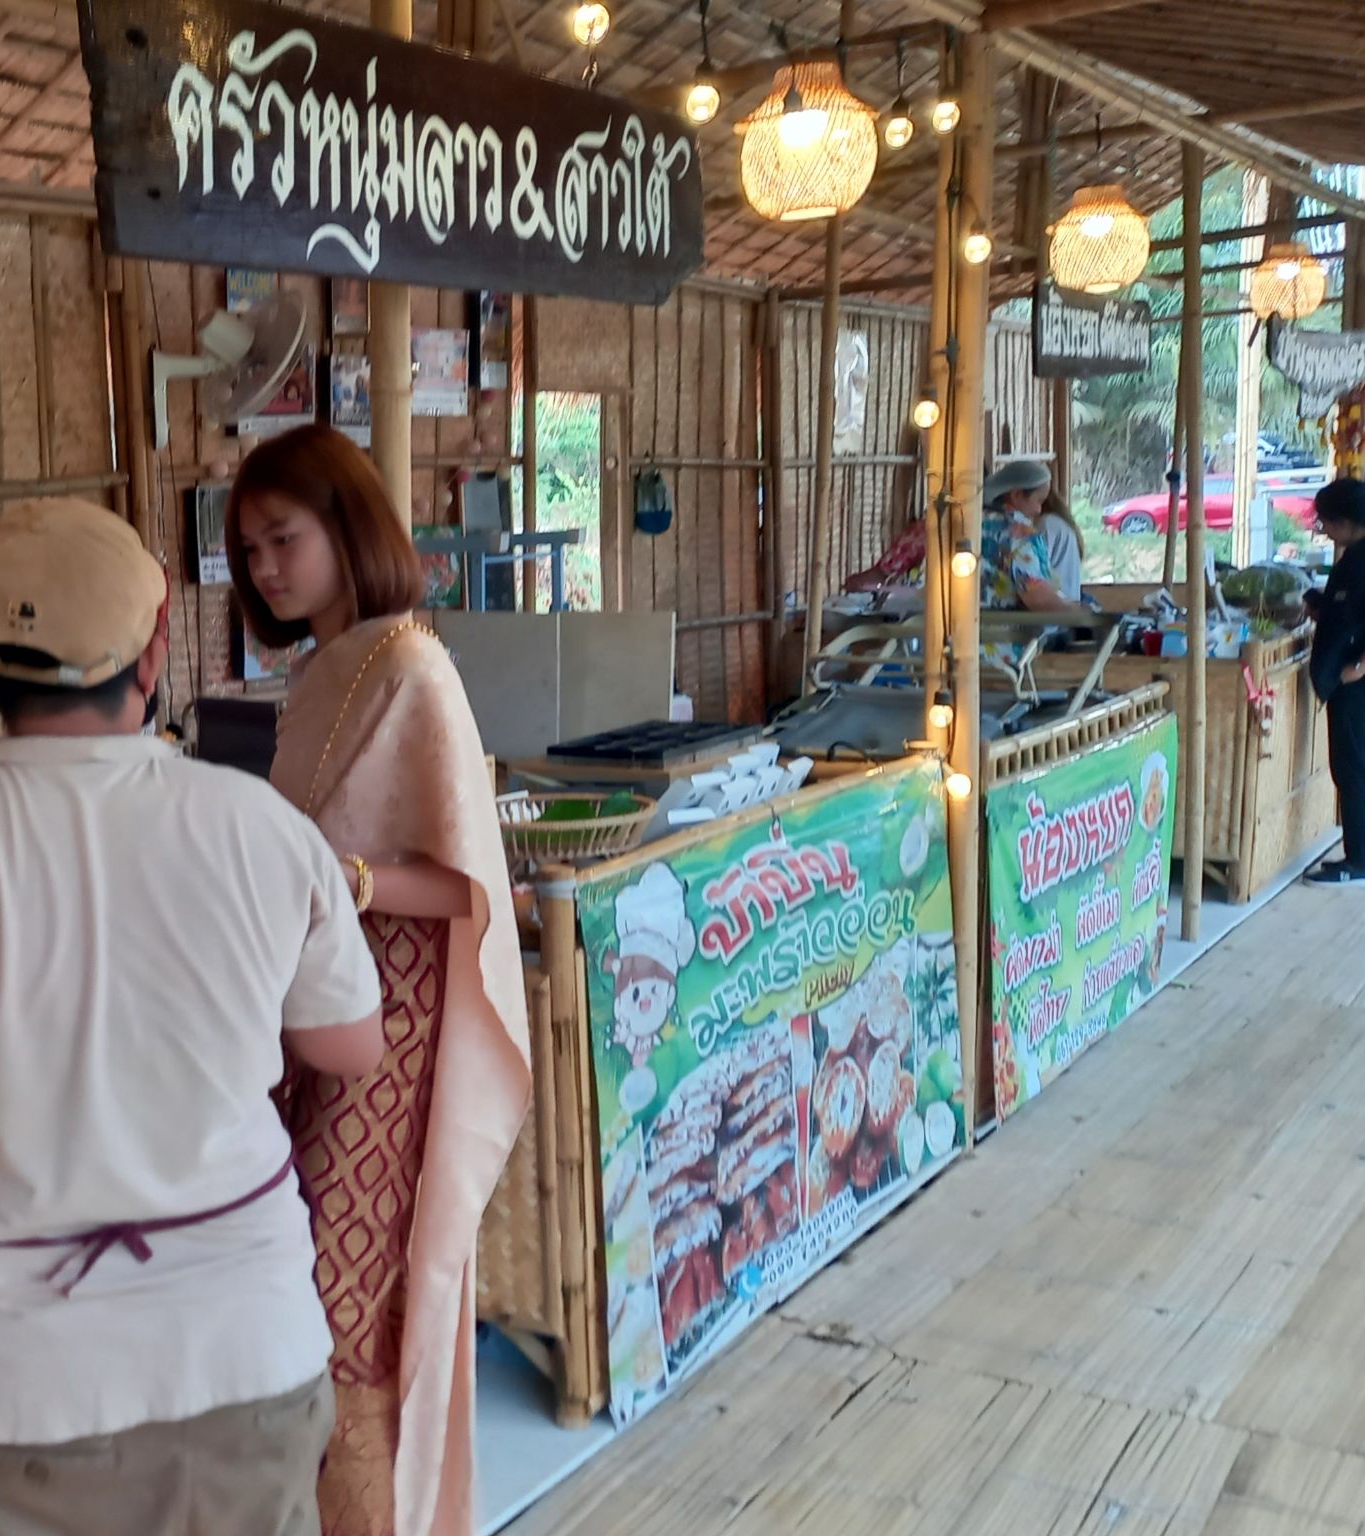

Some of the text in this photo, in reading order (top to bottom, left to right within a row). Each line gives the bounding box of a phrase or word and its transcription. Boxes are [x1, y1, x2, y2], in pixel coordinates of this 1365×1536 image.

[688, 880, 916, 1056] มะพร้าวอ่อน
